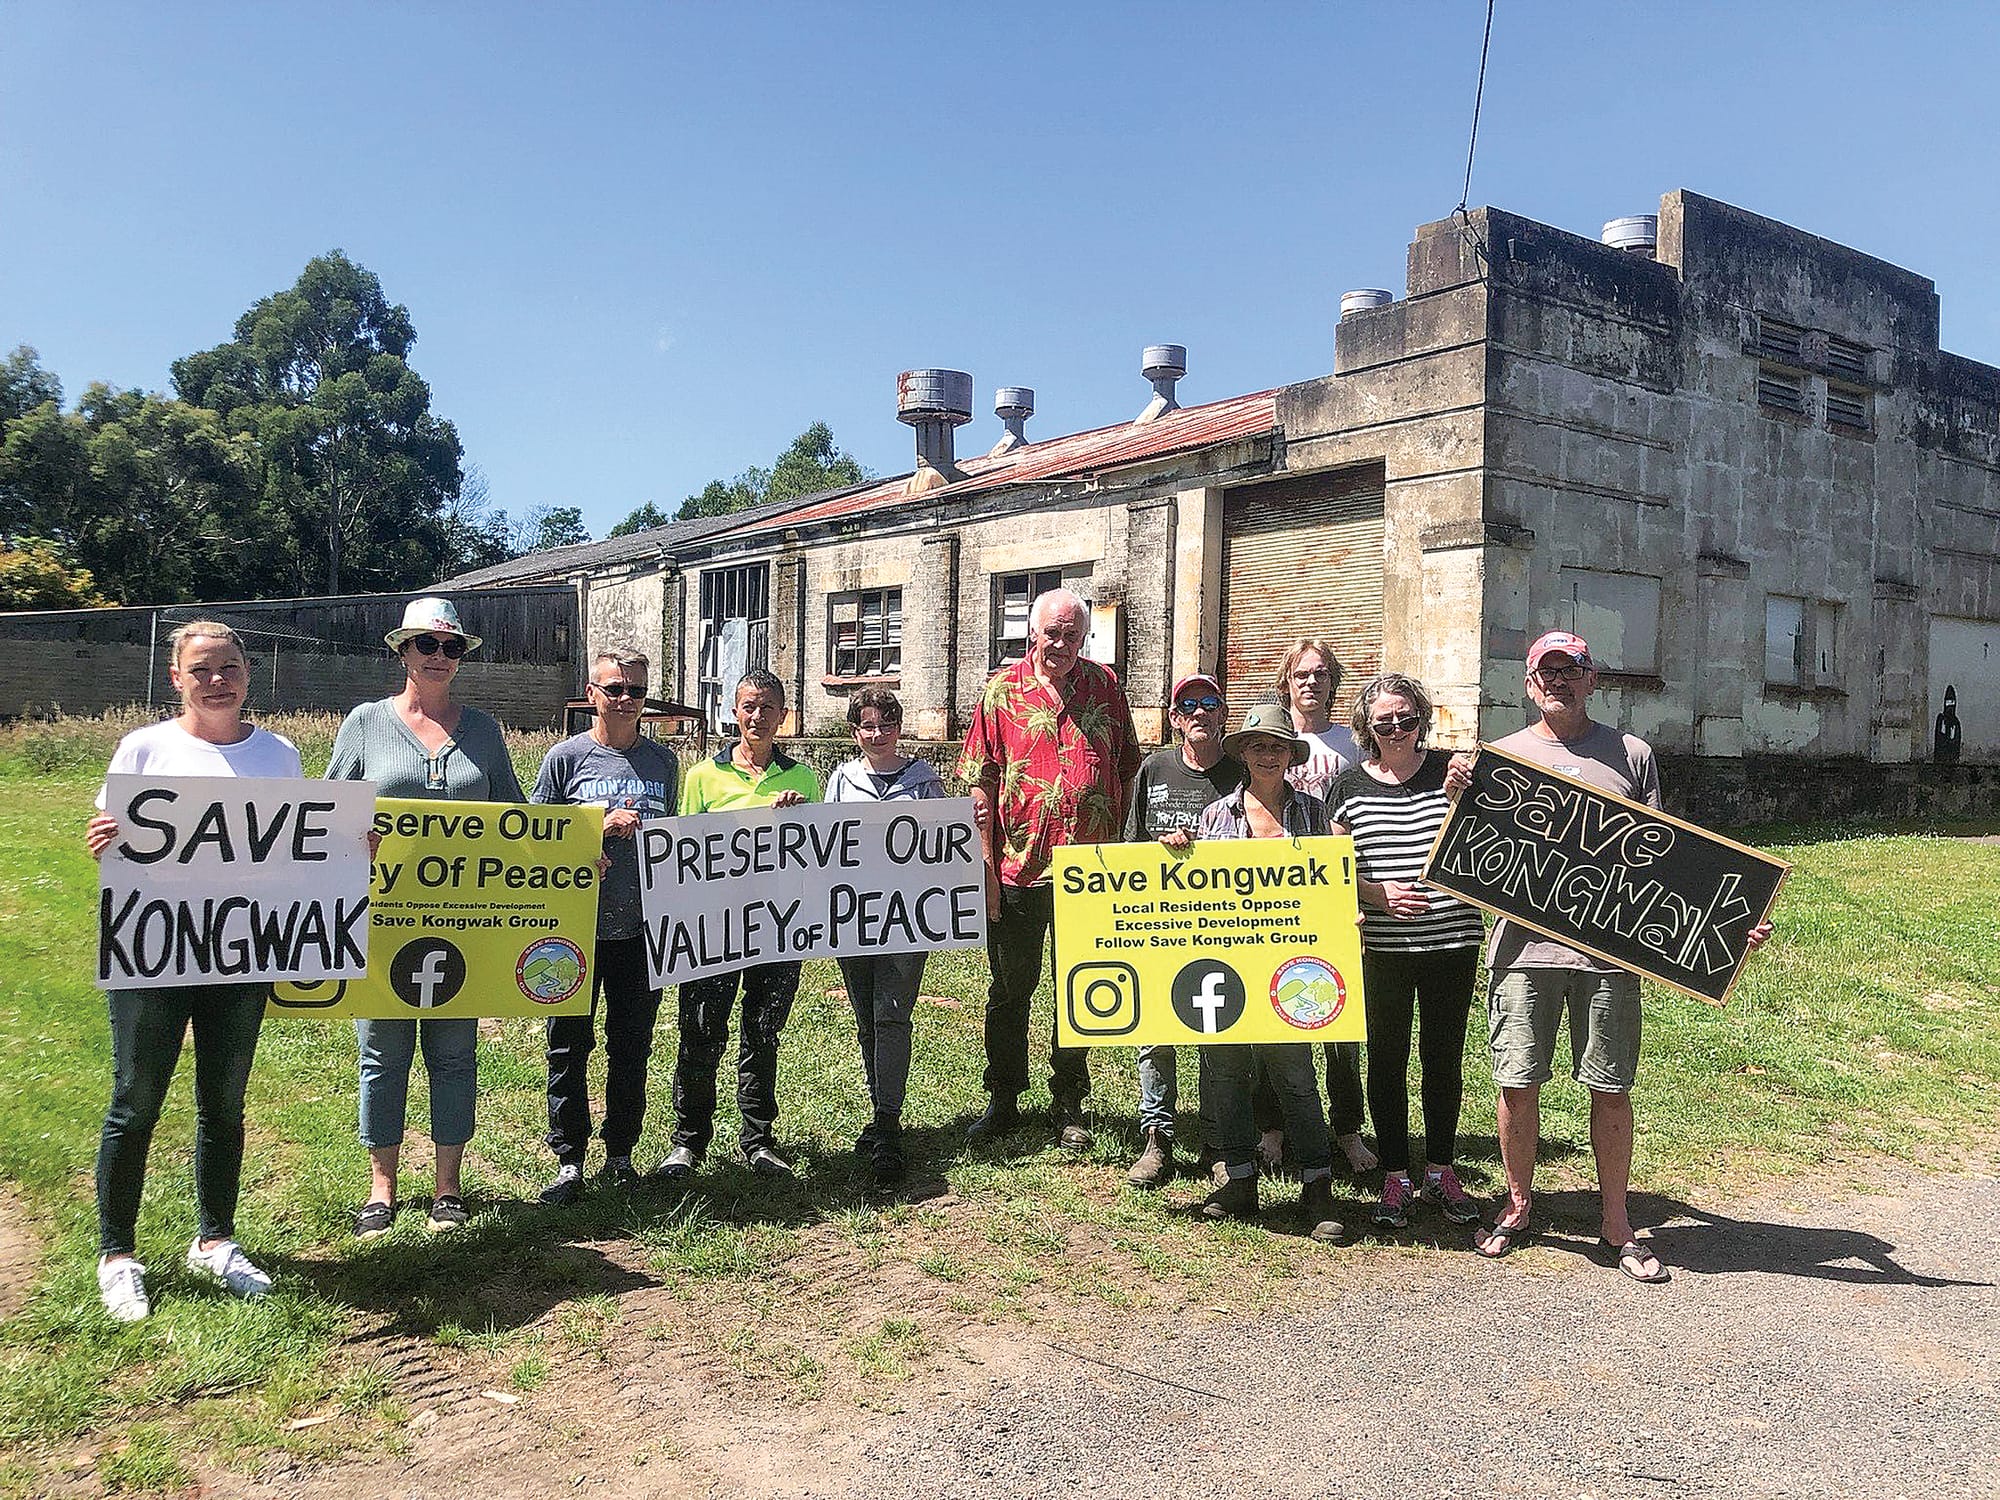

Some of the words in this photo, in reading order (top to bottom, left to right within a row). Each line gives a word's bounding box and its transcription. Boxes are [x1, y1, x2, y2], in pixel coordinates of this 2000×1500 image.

[118, 788, 336, 866] SAVE
[373, 811, 484, 839] serve
[499, 809, 571, 840] Our
[643, 820, 861, 890] PRESERVE
[417, 856, 467, 888] Of
[477, 857, 594, 889] Peace
[1063, 865, 1147, 895] Save
[1161, 857, 1329, 895] Kongwak
[1342, 856, 1351, 885] !
[370, 901, 403, 909] sidents
[406, 901, 441, 910] Oppose
[443, 901, 488, 910] Excessive
[490, 902, 546, 910] Development
[1113, 902, 1154, 914] Local
[1160, 900, 1236, 912] Residents
[1242, 898, 1301, 912] Oppose
[100, 887, 369, 979] KONGWAK
[372, 914, 416, 927] Save
[422, 914, 503, 930] Kongwak
[509, 915, 559, 930] Group
[643, 900, 801, 977] VALLEY
[829, 884, 980, 948] PEACE
[1115, 918, 1193, 931] Excessive
[1198, 915, 1301, 931] Development
[1095, 936, 1146, 949] Follow
[1150, 935, 1187, 948] Save
[1192, 934, 1264, 949] Kongwak
[1270, 932, 1318, 947] Group
[1275, 1005, 1289, 1019] Our
